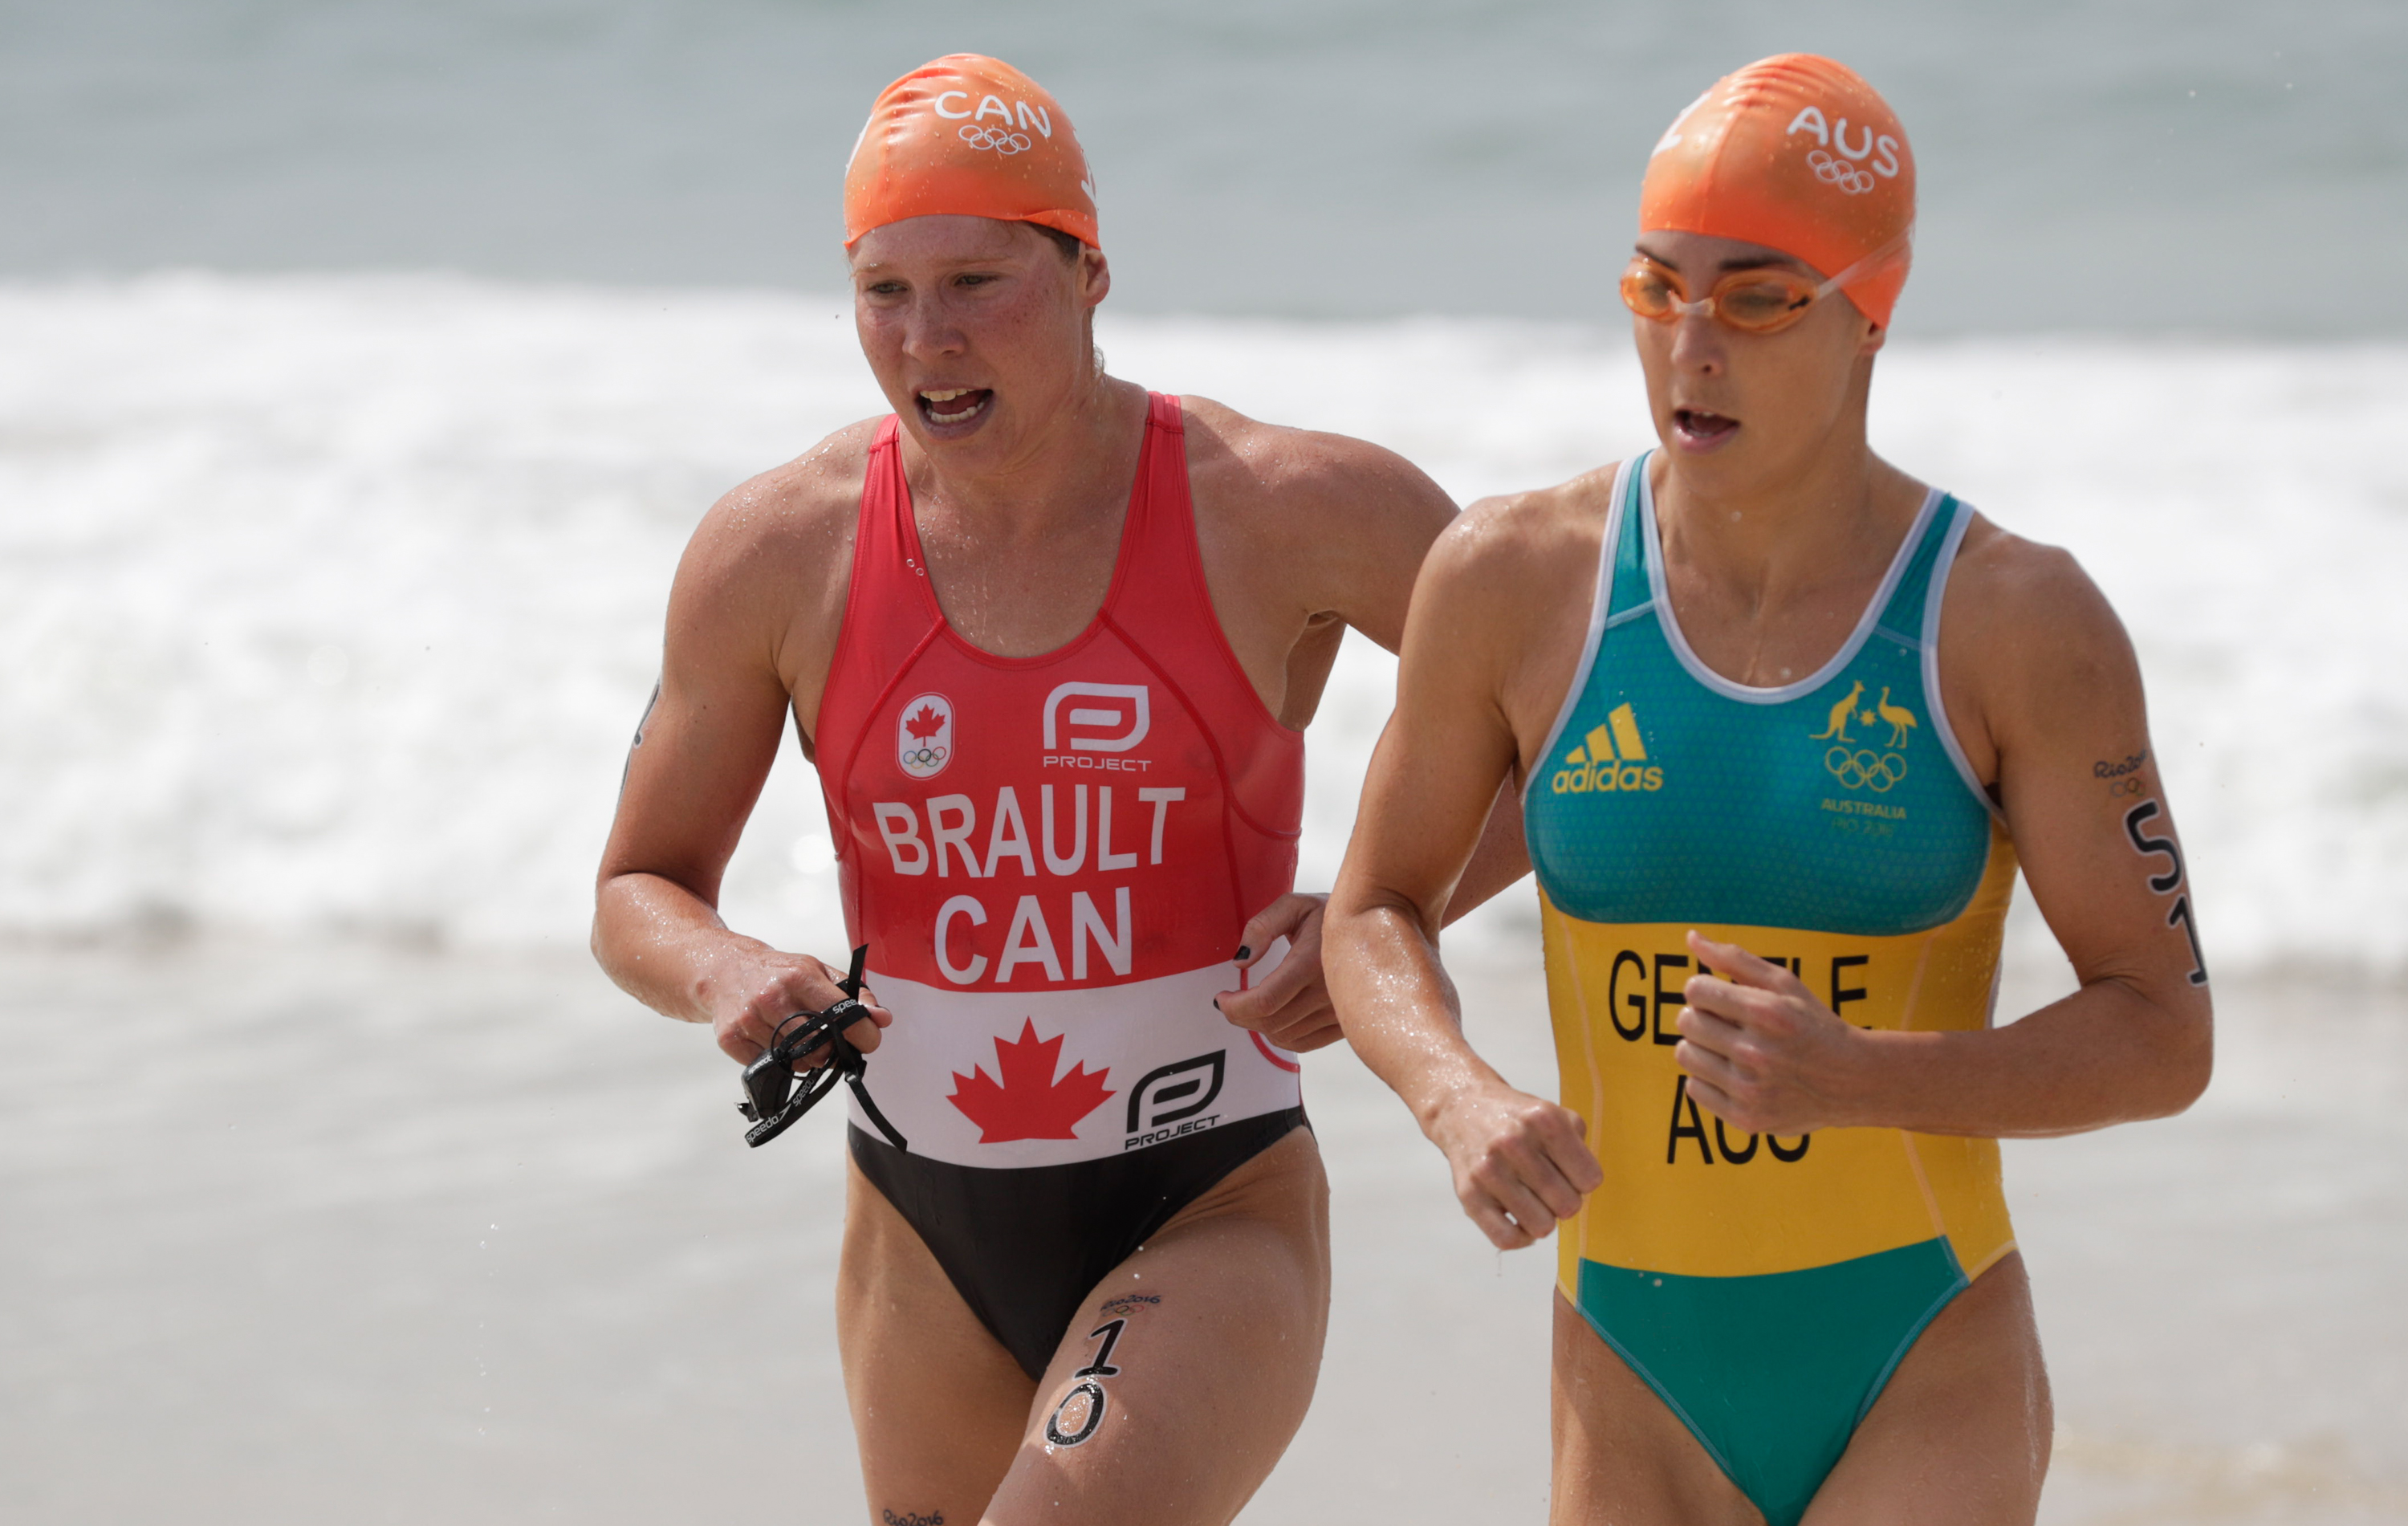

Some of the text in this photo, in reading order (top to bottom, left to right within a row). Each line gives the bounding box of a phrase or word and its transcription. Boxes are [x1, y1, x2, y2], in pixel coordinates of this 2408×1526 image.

[934, 90, 1052, 138] CAN
[1786, 105, 1900, 178] AUS
[1043, 755, 1153, 772] PROJECT
[1551, 761, 1664, 794] adidas
[1820, 797, 1907, 820] AUSTRALIA
[872, 783, 1186, 878] BRAULT
[934, 886, 1133, 985] CAN
[1609, 949, 1873, 1046] GEE
[746, 1116, 780, 1143] speedo
[1125, 1114, 1221, 1151] PROJECT
